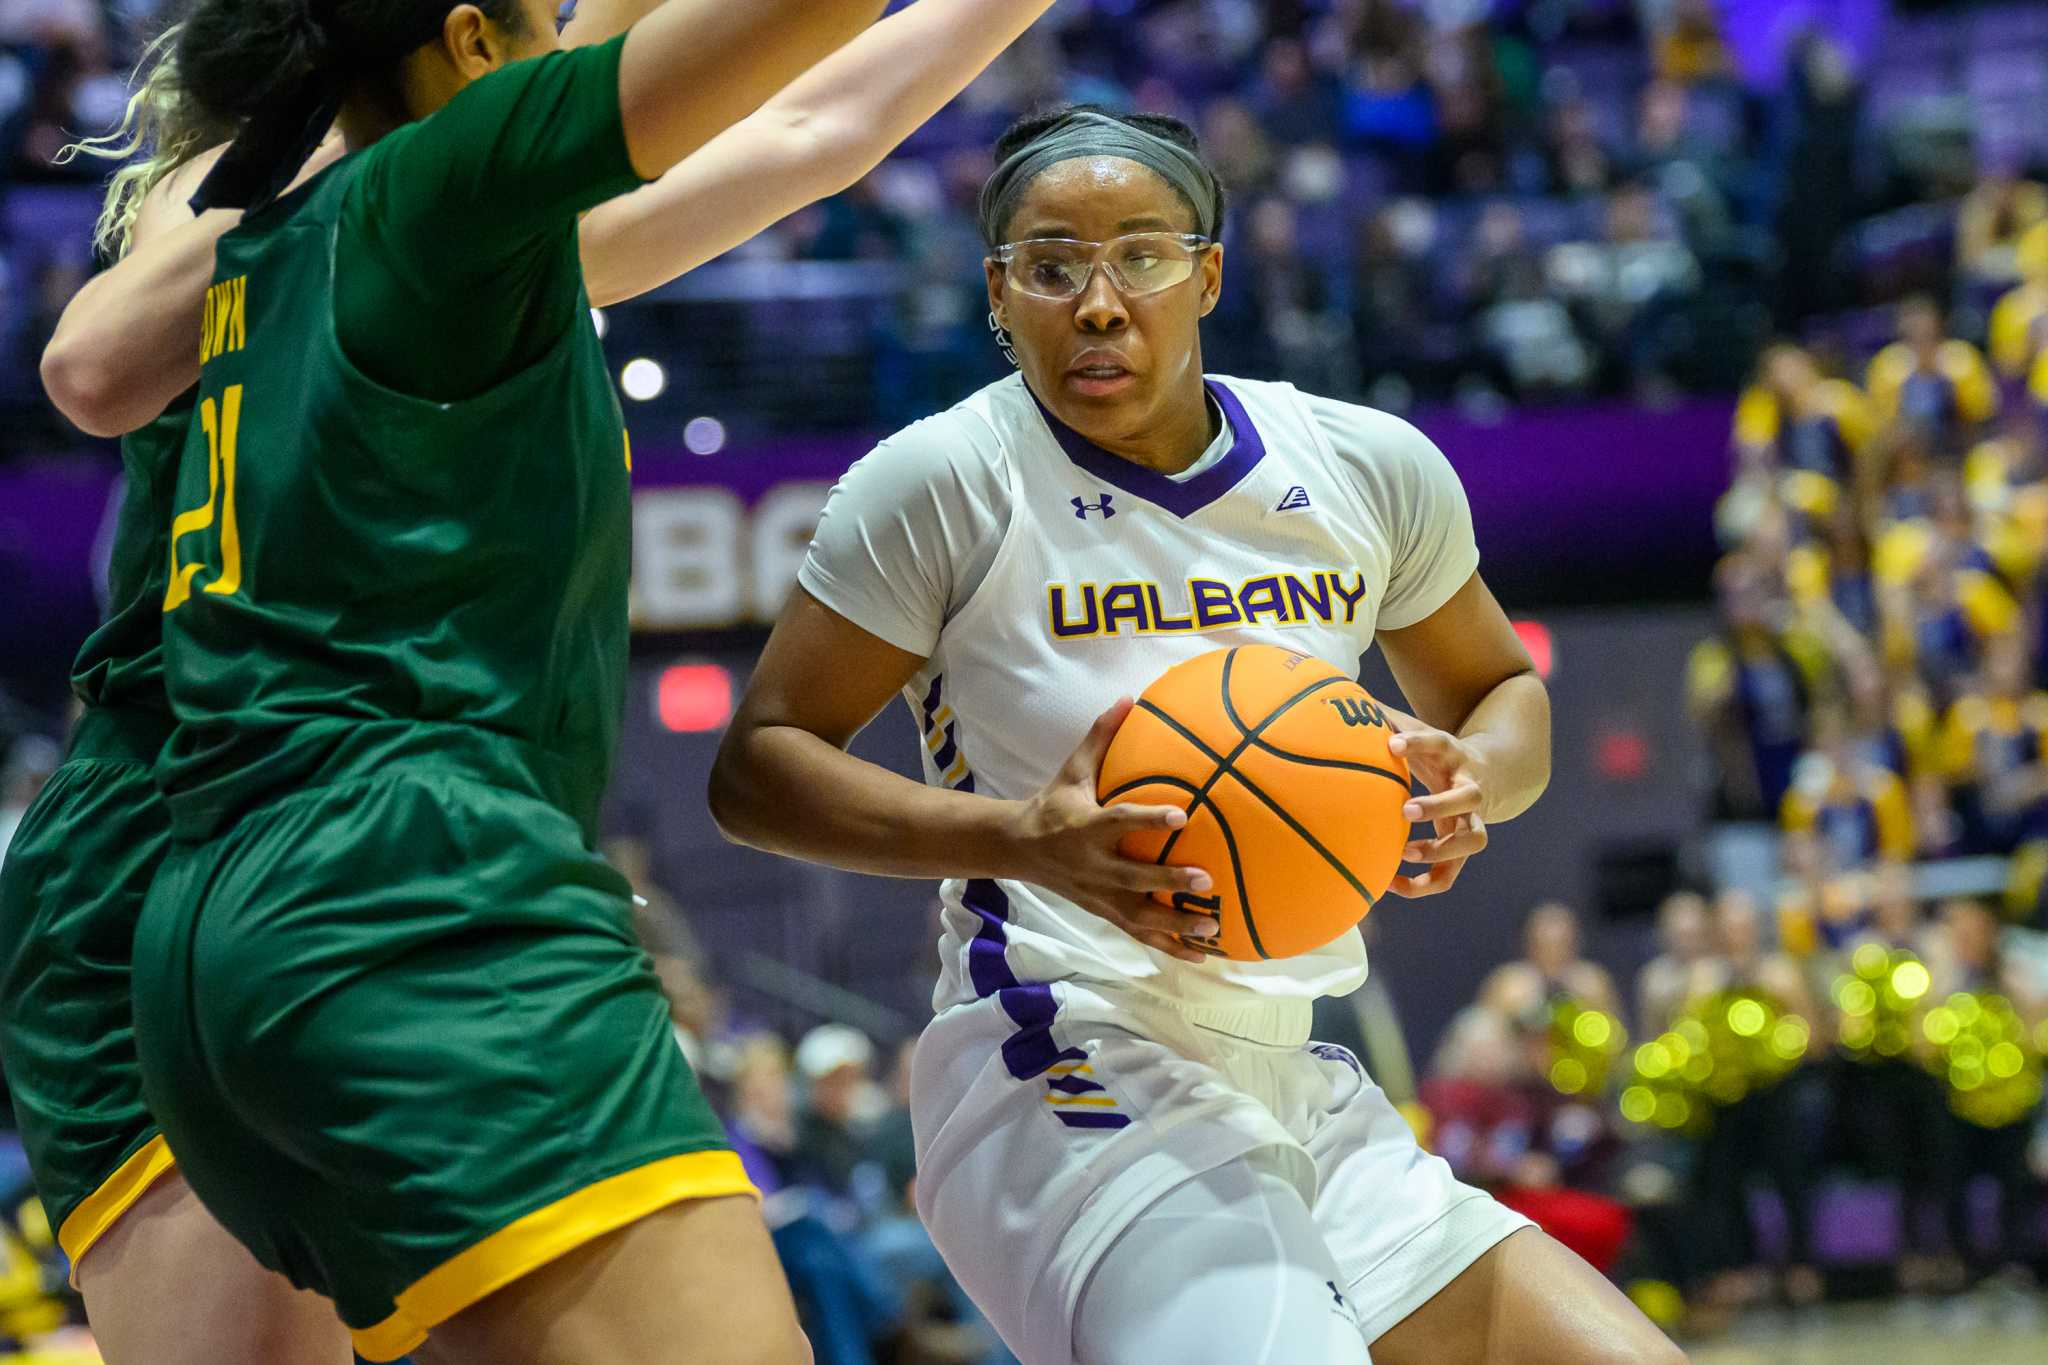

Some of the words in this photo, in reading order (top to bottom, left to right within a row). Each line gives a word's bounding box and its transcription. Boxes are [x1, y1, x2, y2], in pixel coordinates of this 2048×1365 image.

[200, 275, 247, 365] OWN
[162, 384, 243, 613] 21
[1047, 570, 1367, 640] UALBANY
